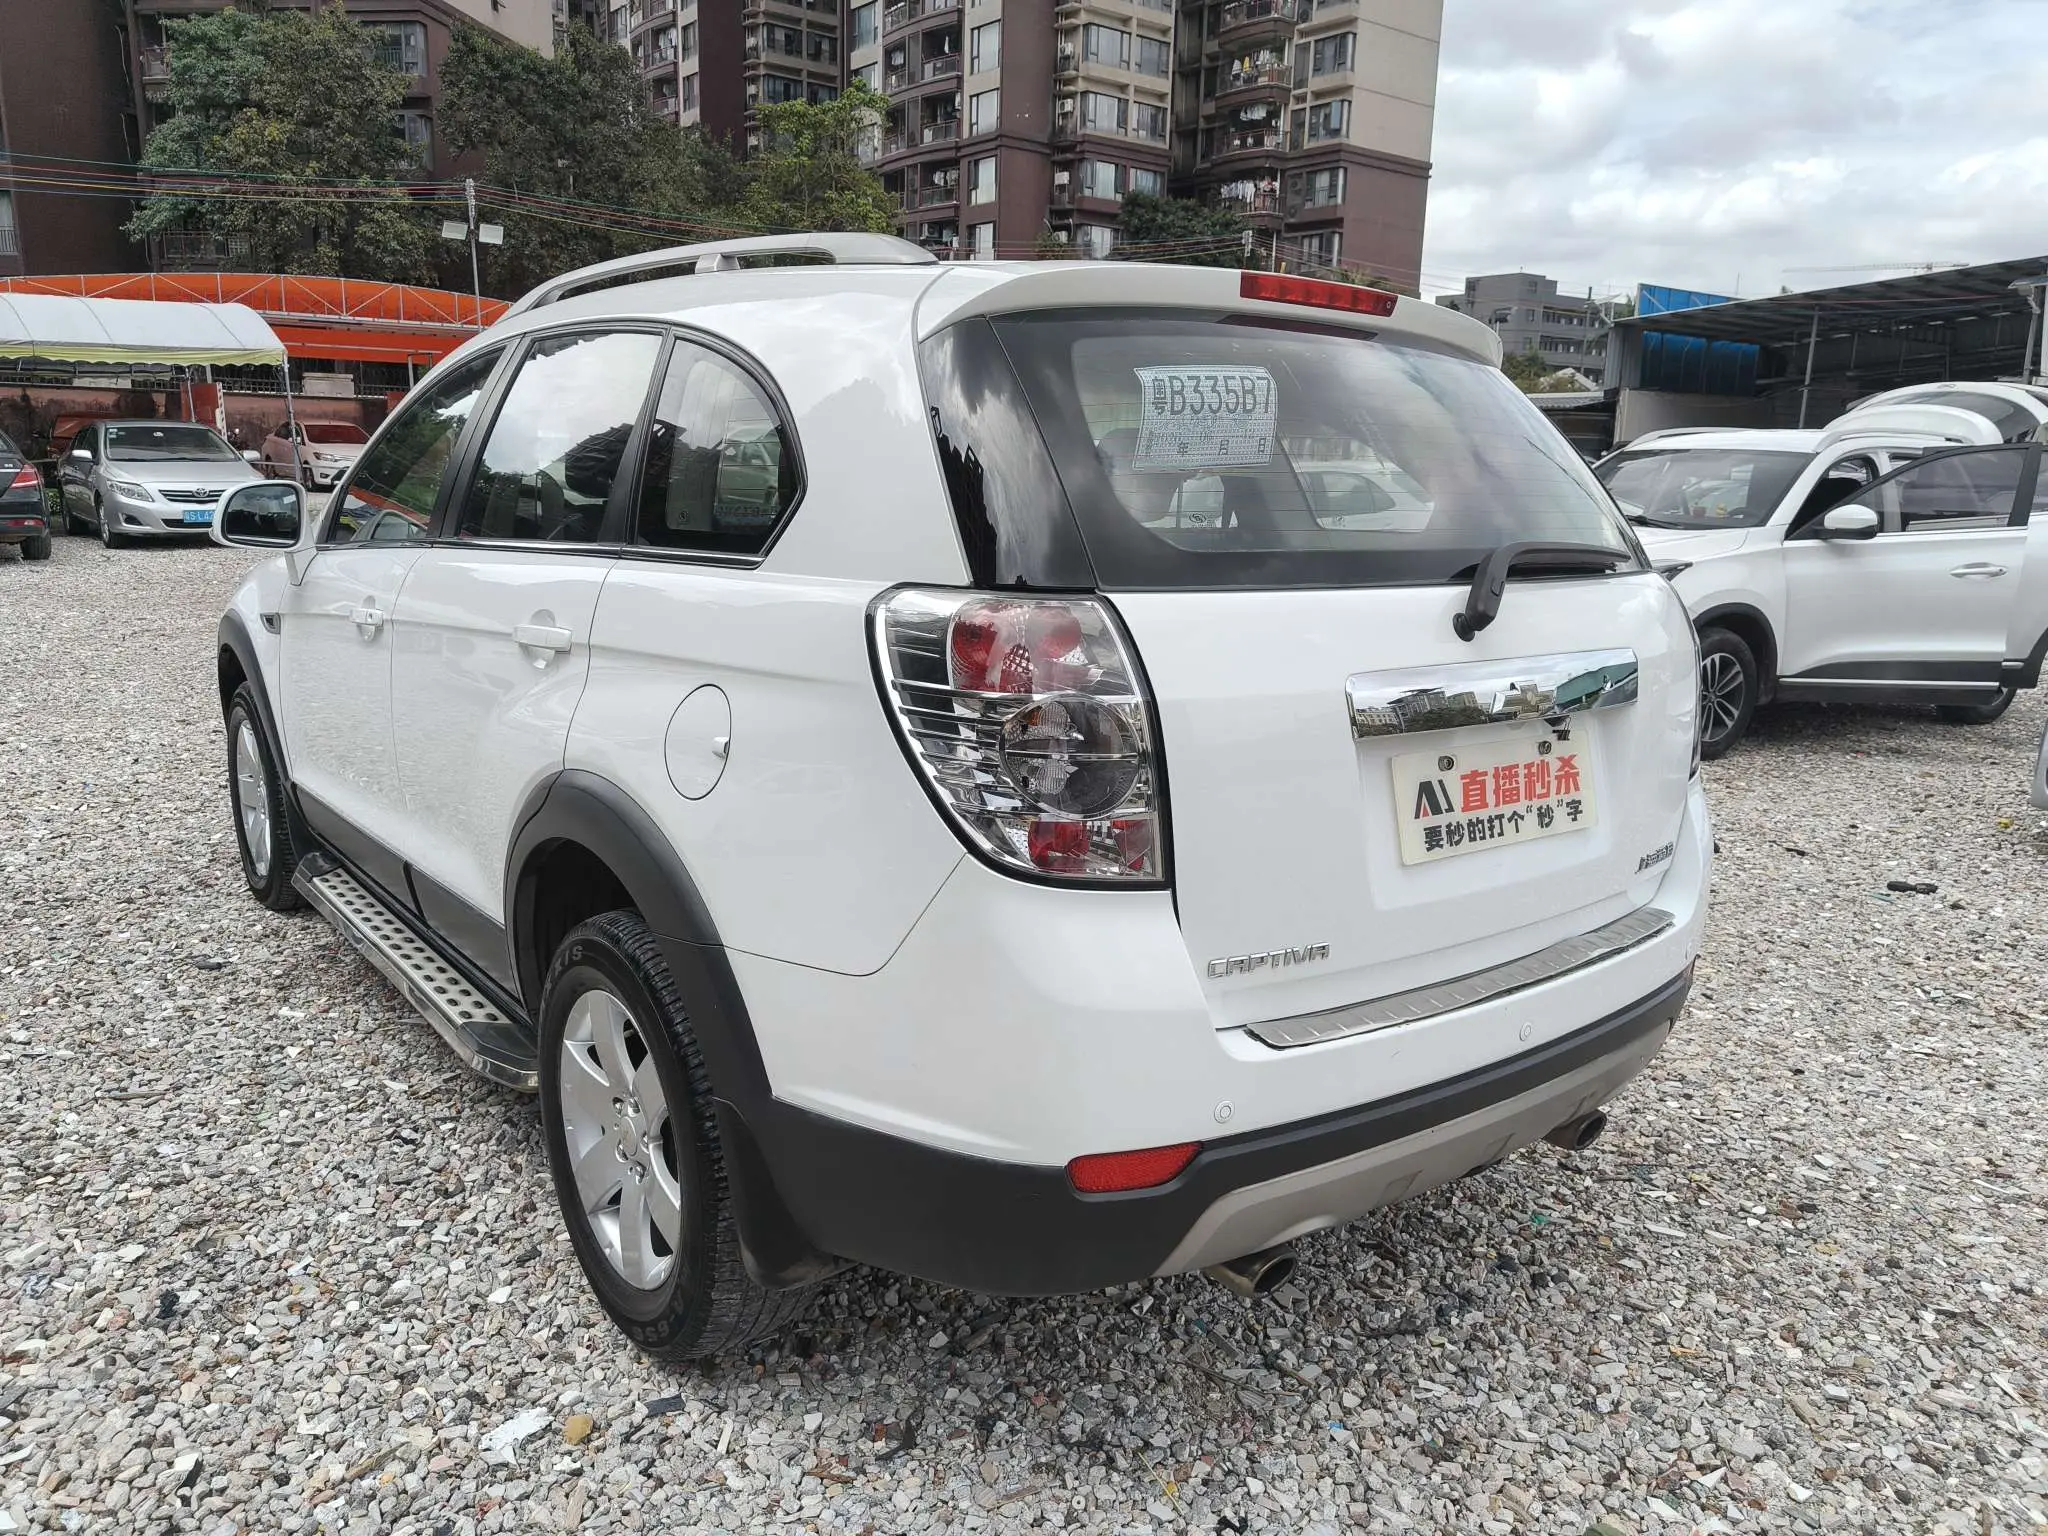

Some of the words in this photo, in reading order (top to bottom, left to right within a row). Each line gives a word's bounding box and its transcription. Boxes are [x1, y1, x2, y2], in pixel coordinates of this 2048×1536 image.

[1152, 375, 1271, 416] 粤B335B7
[1460, 754, 1581, 813] 直播秒杀
[1207, 941, 1330, 978] CAPTIVA
